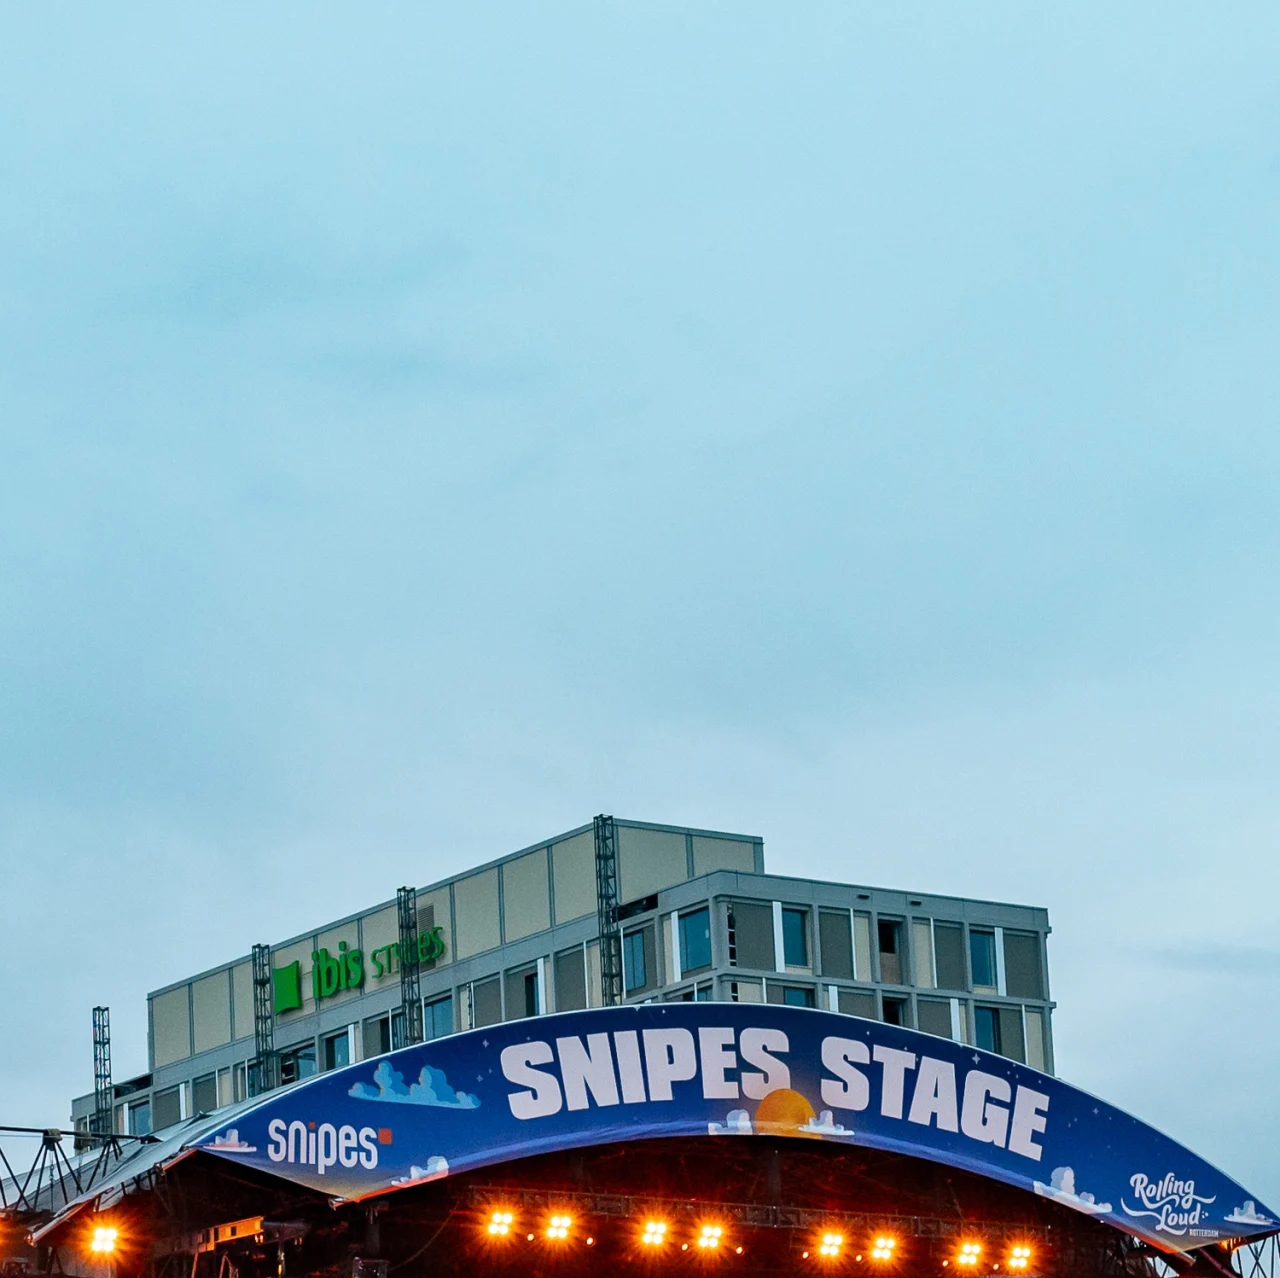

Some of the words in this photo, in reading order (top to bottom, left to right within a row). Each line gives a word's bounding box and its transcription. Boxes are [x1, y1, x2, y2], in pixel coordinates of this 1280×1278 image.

[311, 940, 364, 1001] ibis
[500, 1027, 792, 1120] SNIPES
[820, 1036, 1050, 1161] STAGE
[267, 1119, 379, 1175] snipes
[1120, 1197, 1201, 1236] Loud
[1129, 1172, 1216, 1210] Rolling
